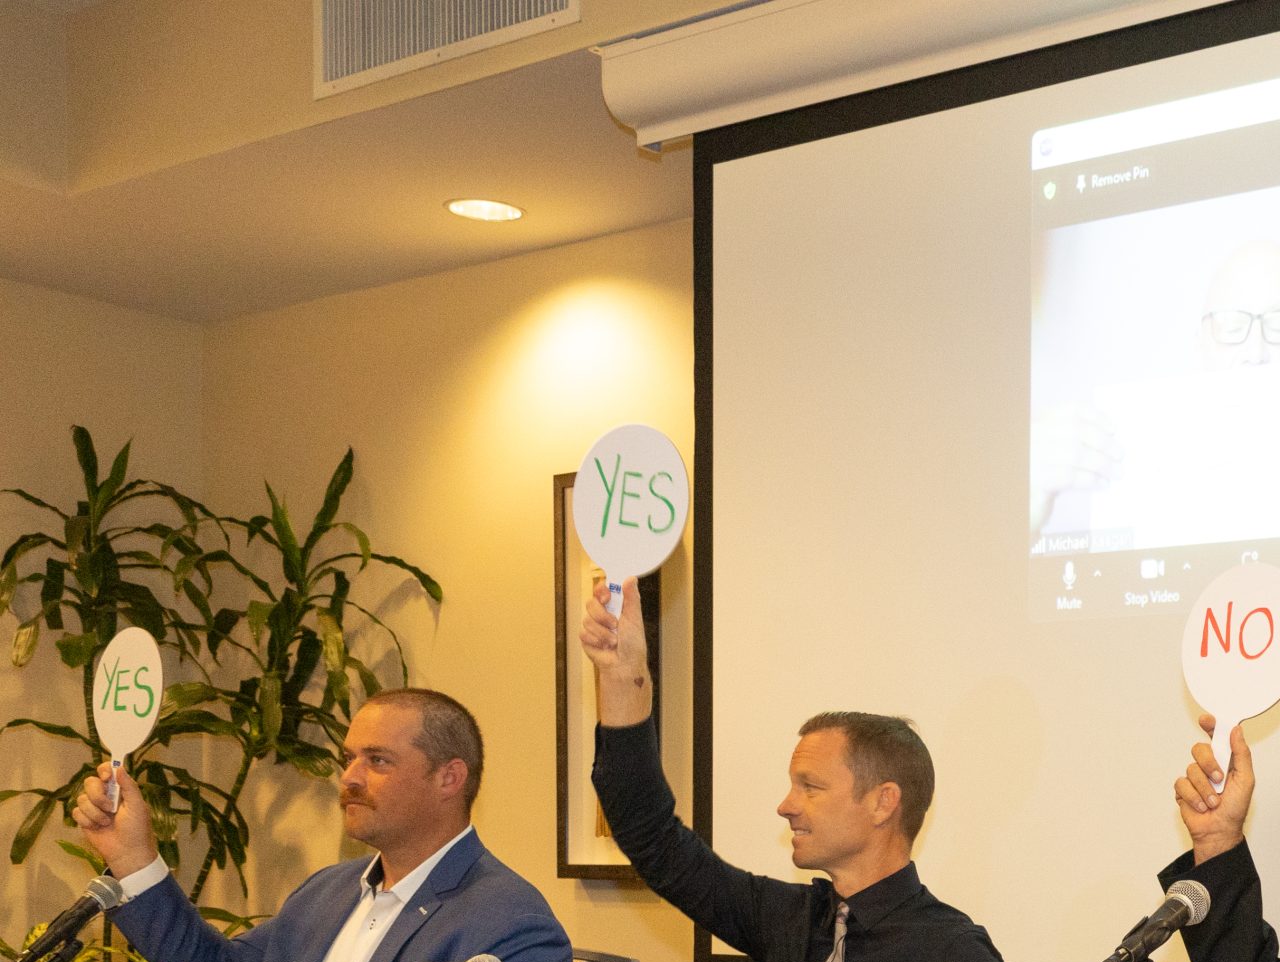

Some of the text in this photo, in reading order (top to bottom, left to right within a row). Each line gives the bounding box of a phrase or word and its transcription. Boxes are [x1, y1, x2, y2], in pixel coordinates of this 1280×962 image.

[1091, 165, 1150, 189] Remove Pin
[593, 453, 675, 538] YES
[1048, 534, 1089, 552] Michael
[1056, 597, 1083, 610] Mute
[1124, 588, 1181, 608] Stop Video
[1200, 600, 1275, 660] NO
[101, 656, 155, 719] YES
